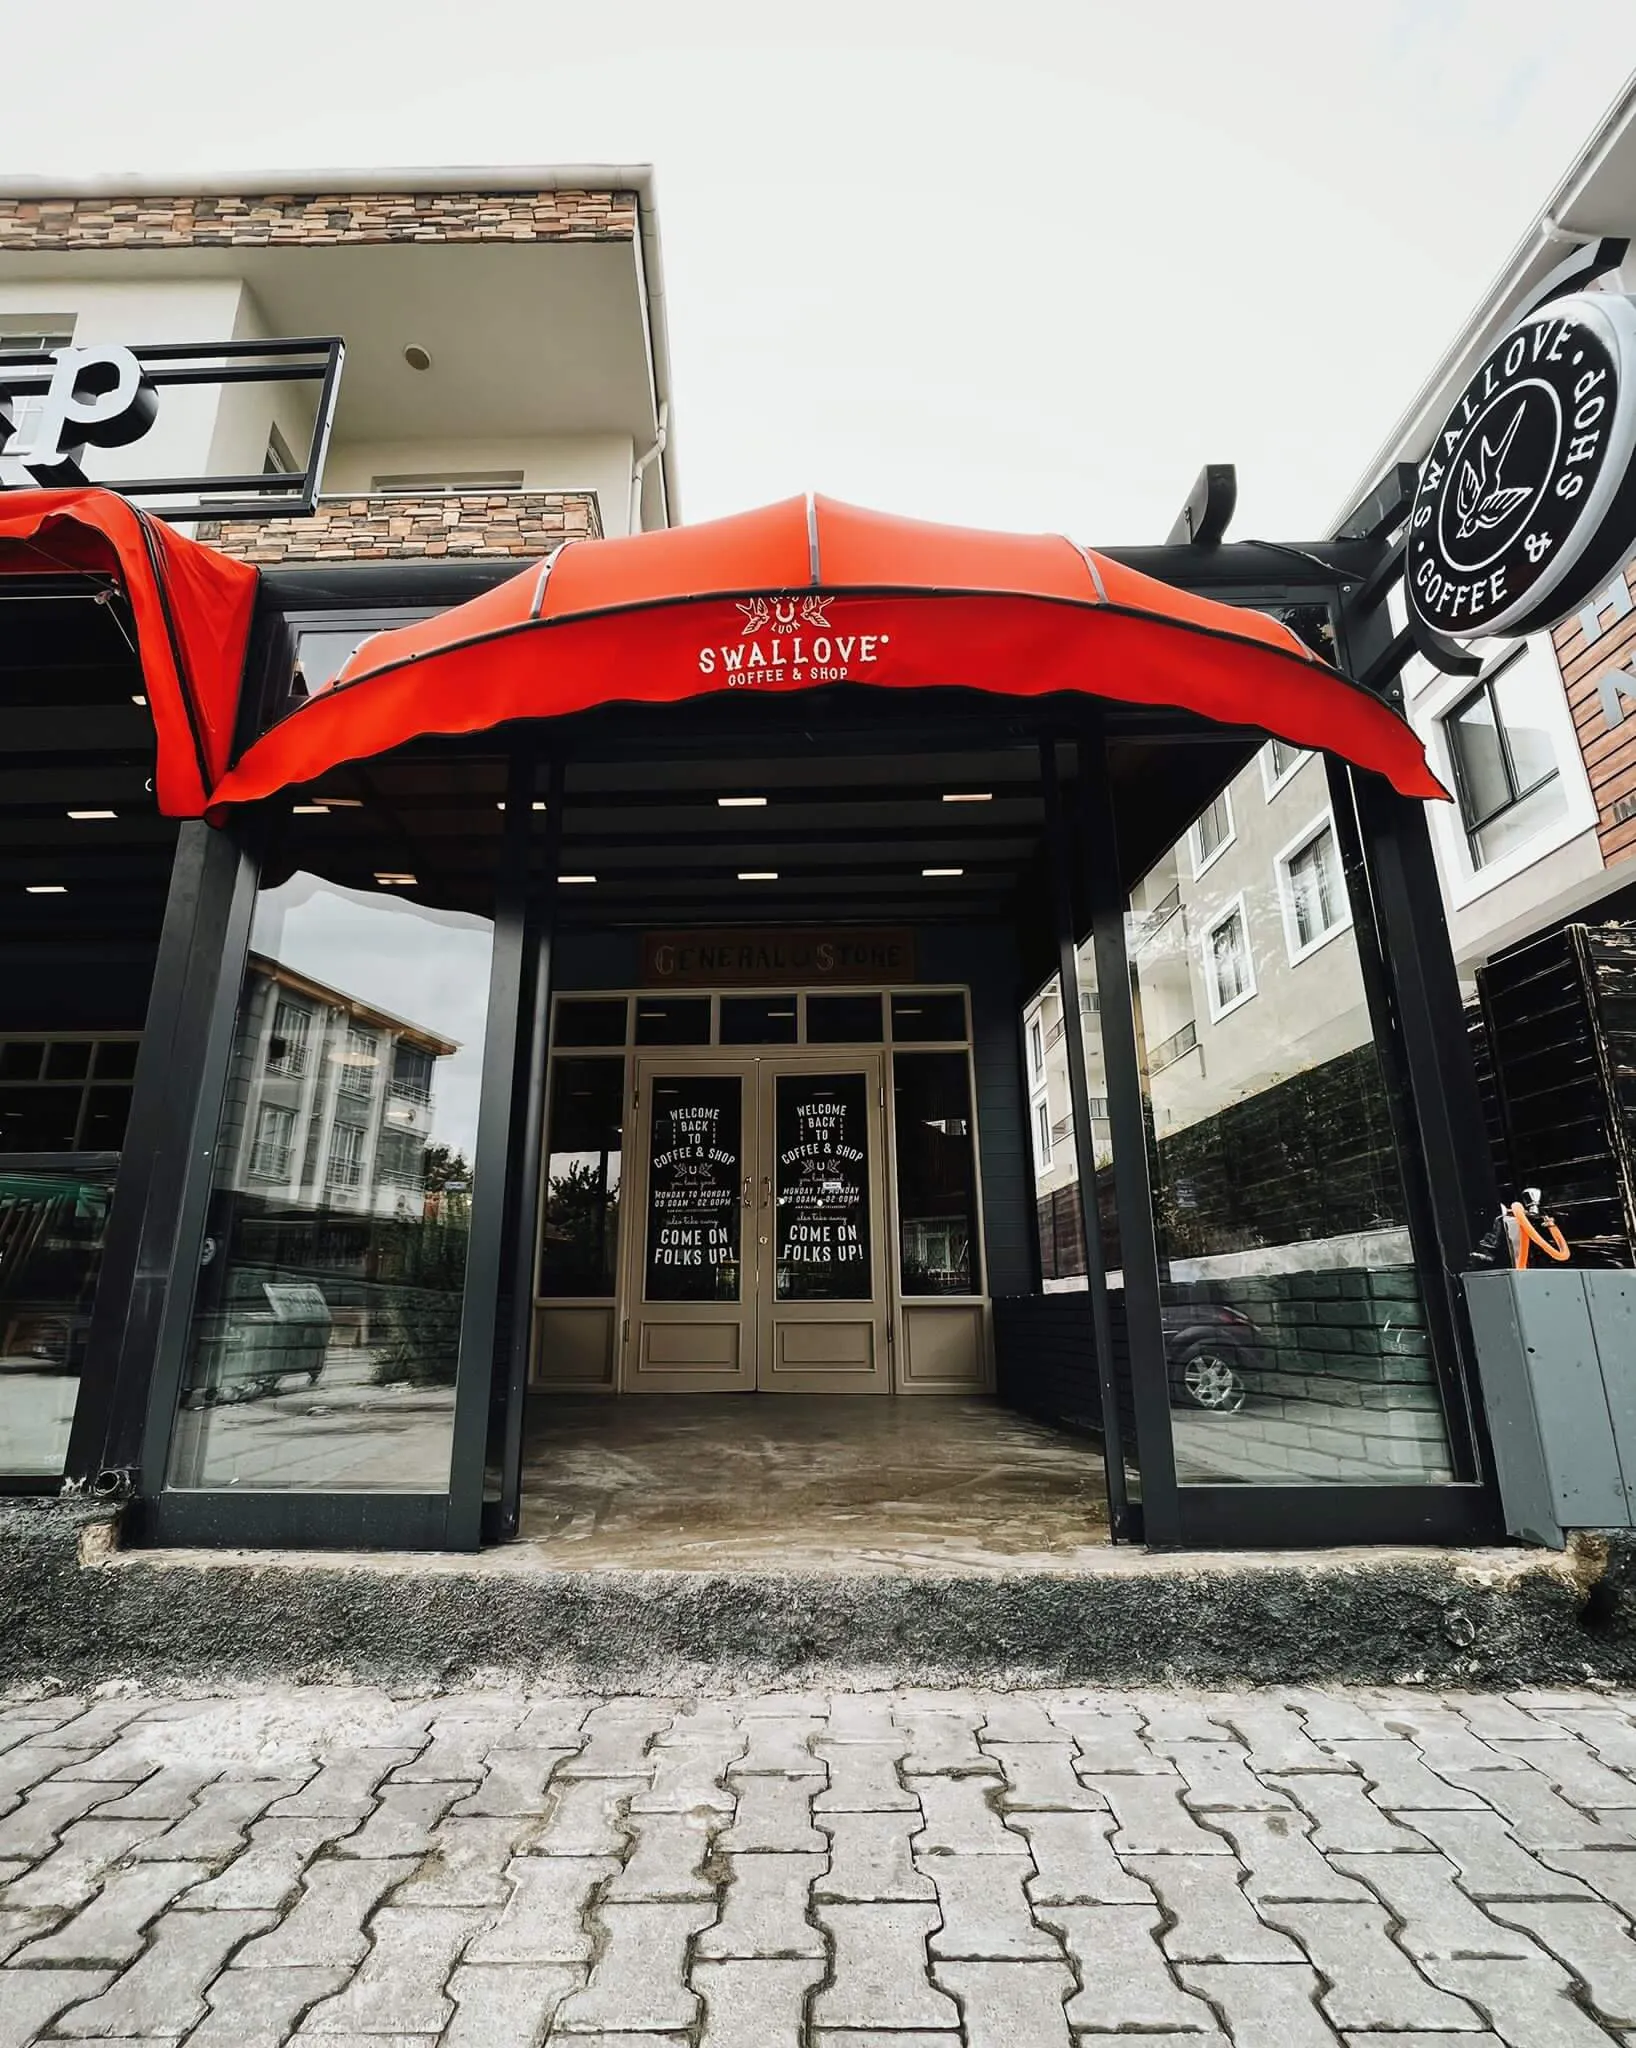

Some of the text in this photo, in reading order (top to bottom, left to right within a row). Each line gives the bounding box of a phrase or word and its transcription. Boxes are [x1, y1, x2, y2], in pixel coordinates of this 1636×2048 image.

[1556, 368, 1606, 500] SHOP
[1524, 530, 1552, 563] &
[1417, 558, 1508, 617] COFFEE
[728, 667, 848, 686] COFFEE & SHOP
[669, 1107, 720, 1120] WELCOME
[796, 1103, 847, 1116] WELCOME
[681, 1120, 709, 1132] BACK
[808, 1117, 835, 1128] BACK
[688, 1133, 701, 1144] TO
[815, 1129, 828, 1141] TO
[653, 1146, 736, 1168] COFFEE & SHOP
[781, 1143, 864, 1164] COFFEE & SHOP
[654, 1190, 731, 1199] MONDAY TO MONDAY
[783, 1187, 813, 1195] MONDAY
[660, 1227, 728, 1246] COME ON
[789, 1224, 857, 1242] COME ON
[654, 1247, 735, 1265] FOLKS UP!
[783, 1243, 864, 1262] FOLKS UP!
